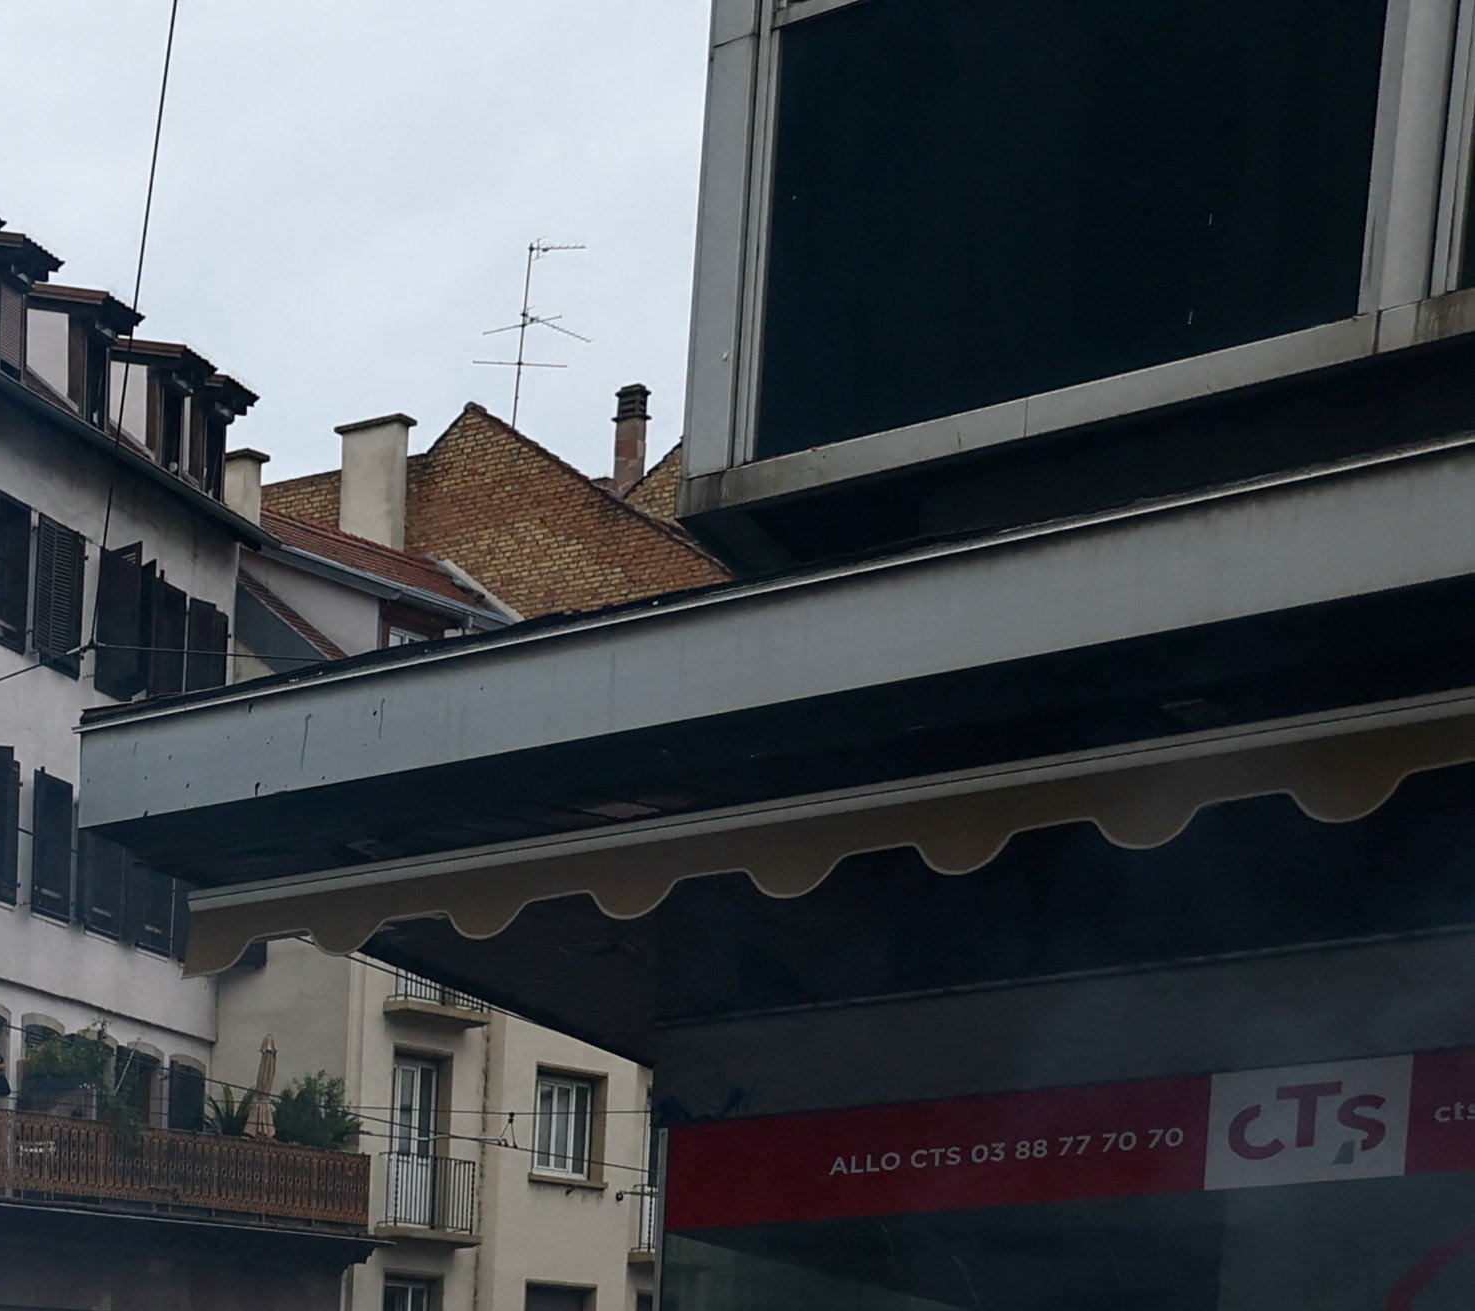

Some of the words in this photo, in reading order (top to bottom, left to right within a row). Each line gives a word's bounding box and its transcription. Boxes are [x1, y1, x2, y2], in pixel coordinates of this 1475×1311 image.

[829, 1152, 901, 1176] ALLO
[910, 1147, 961, 1169] CTS
[971, 1142, 1005, 1164] 03
[1014, 1139, 1048, 1160] 88
[1058, 1135, 1091, 1156] 77
[1101, 1131, 1137, 1153] 70
[1147, 1127, 1184, 1149] 70
[1228, 1081, 1386, 1164] CTS
